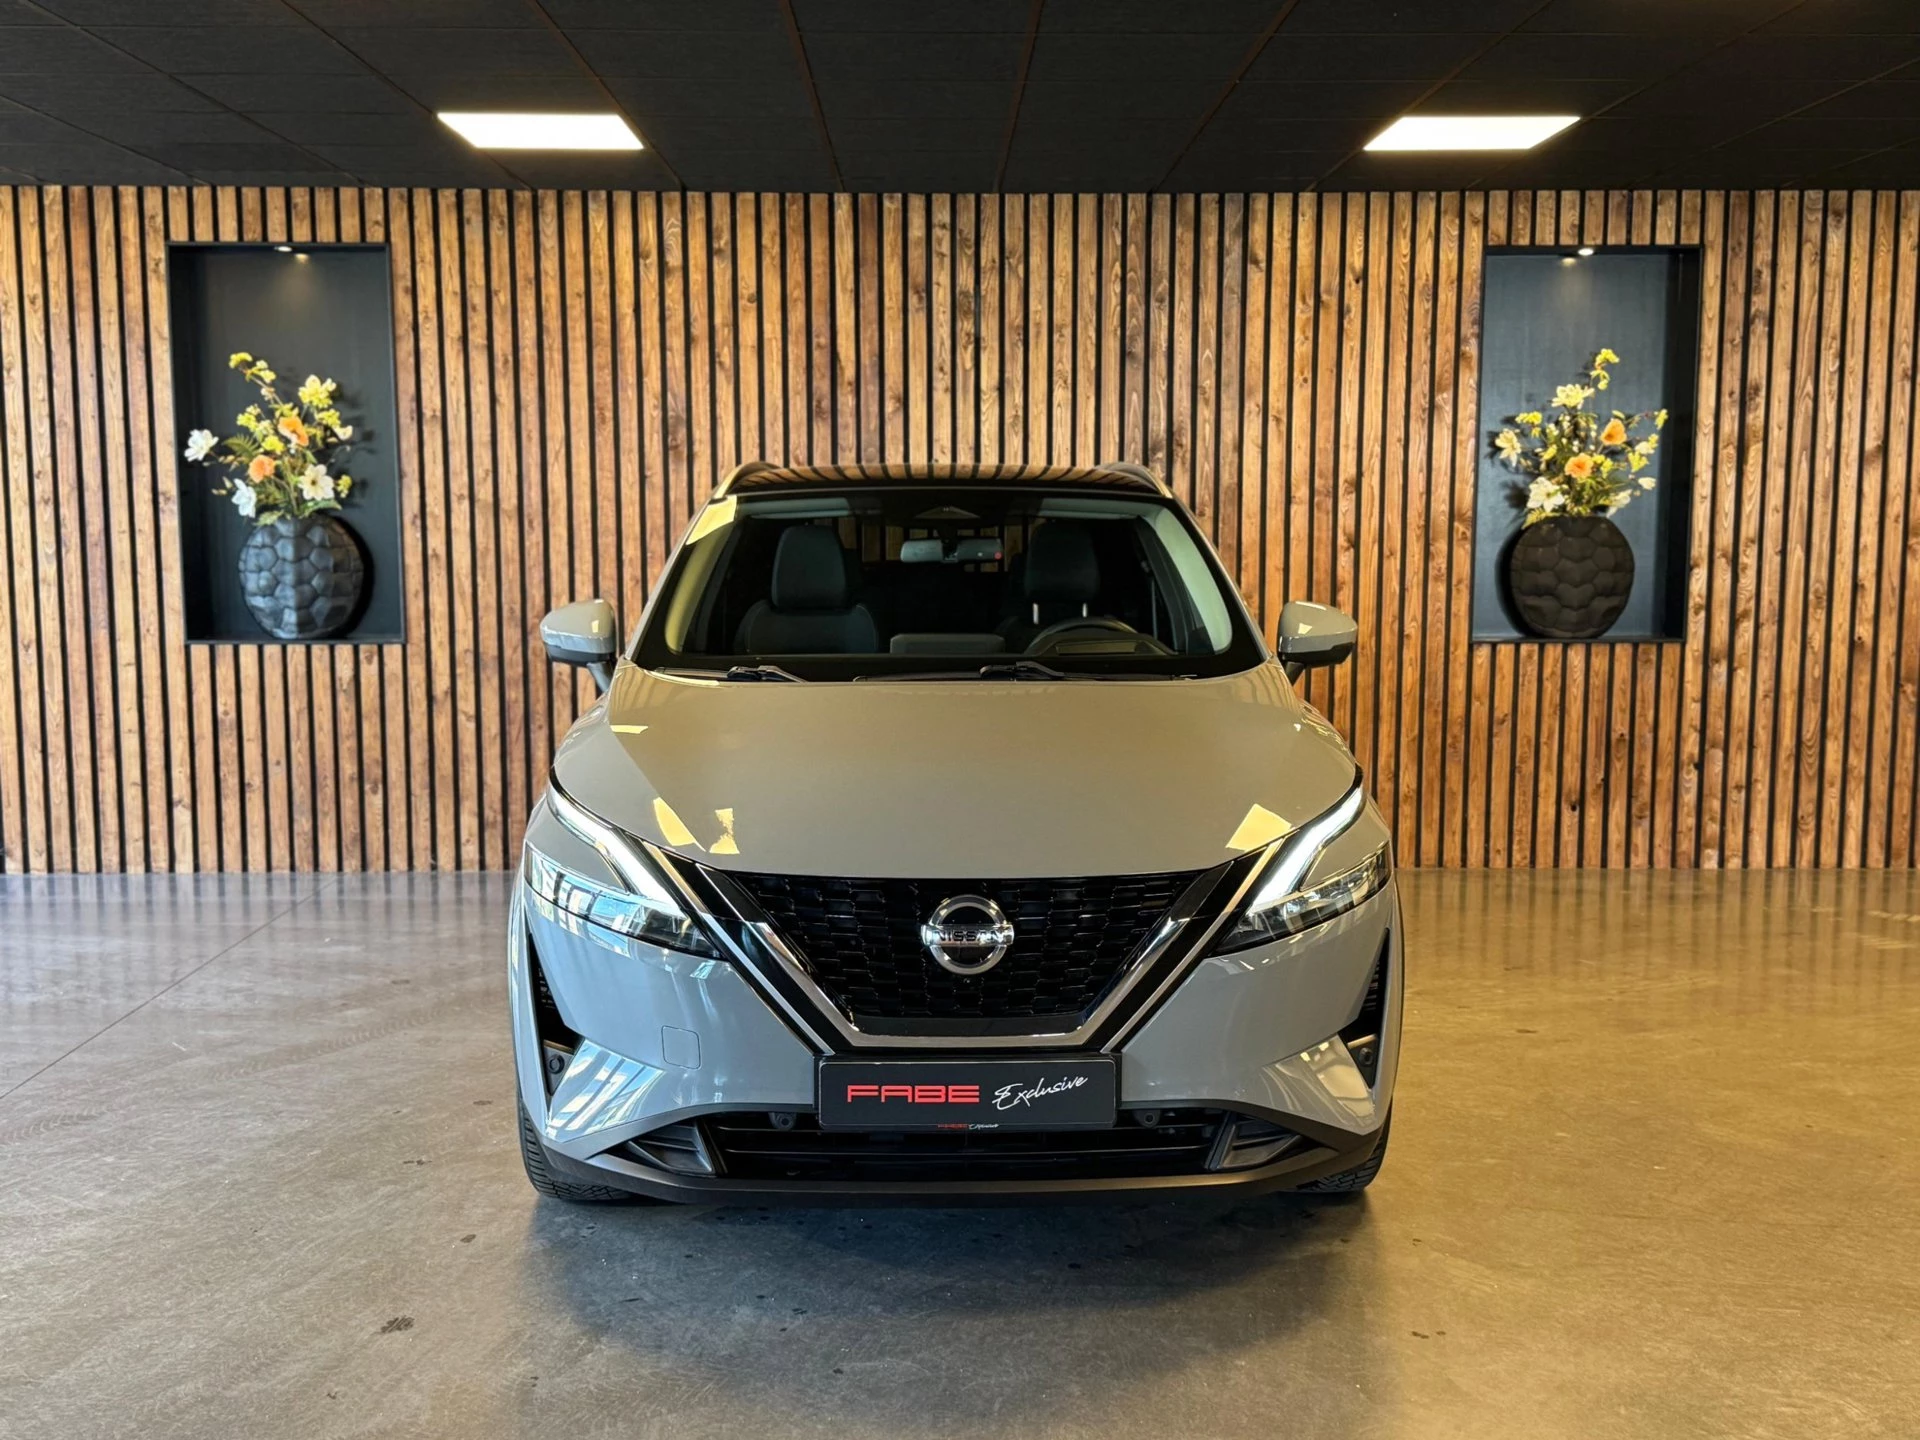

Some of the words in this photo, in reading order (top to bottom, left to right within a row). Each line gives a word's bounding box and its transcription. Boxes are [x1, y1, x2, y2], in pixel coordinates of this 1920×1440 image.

[936, 930, 1003, 942] NISSAN
[847, 1085, 979, 1103] FABE
[992, 1076, 1089, 1110] Exclusive
